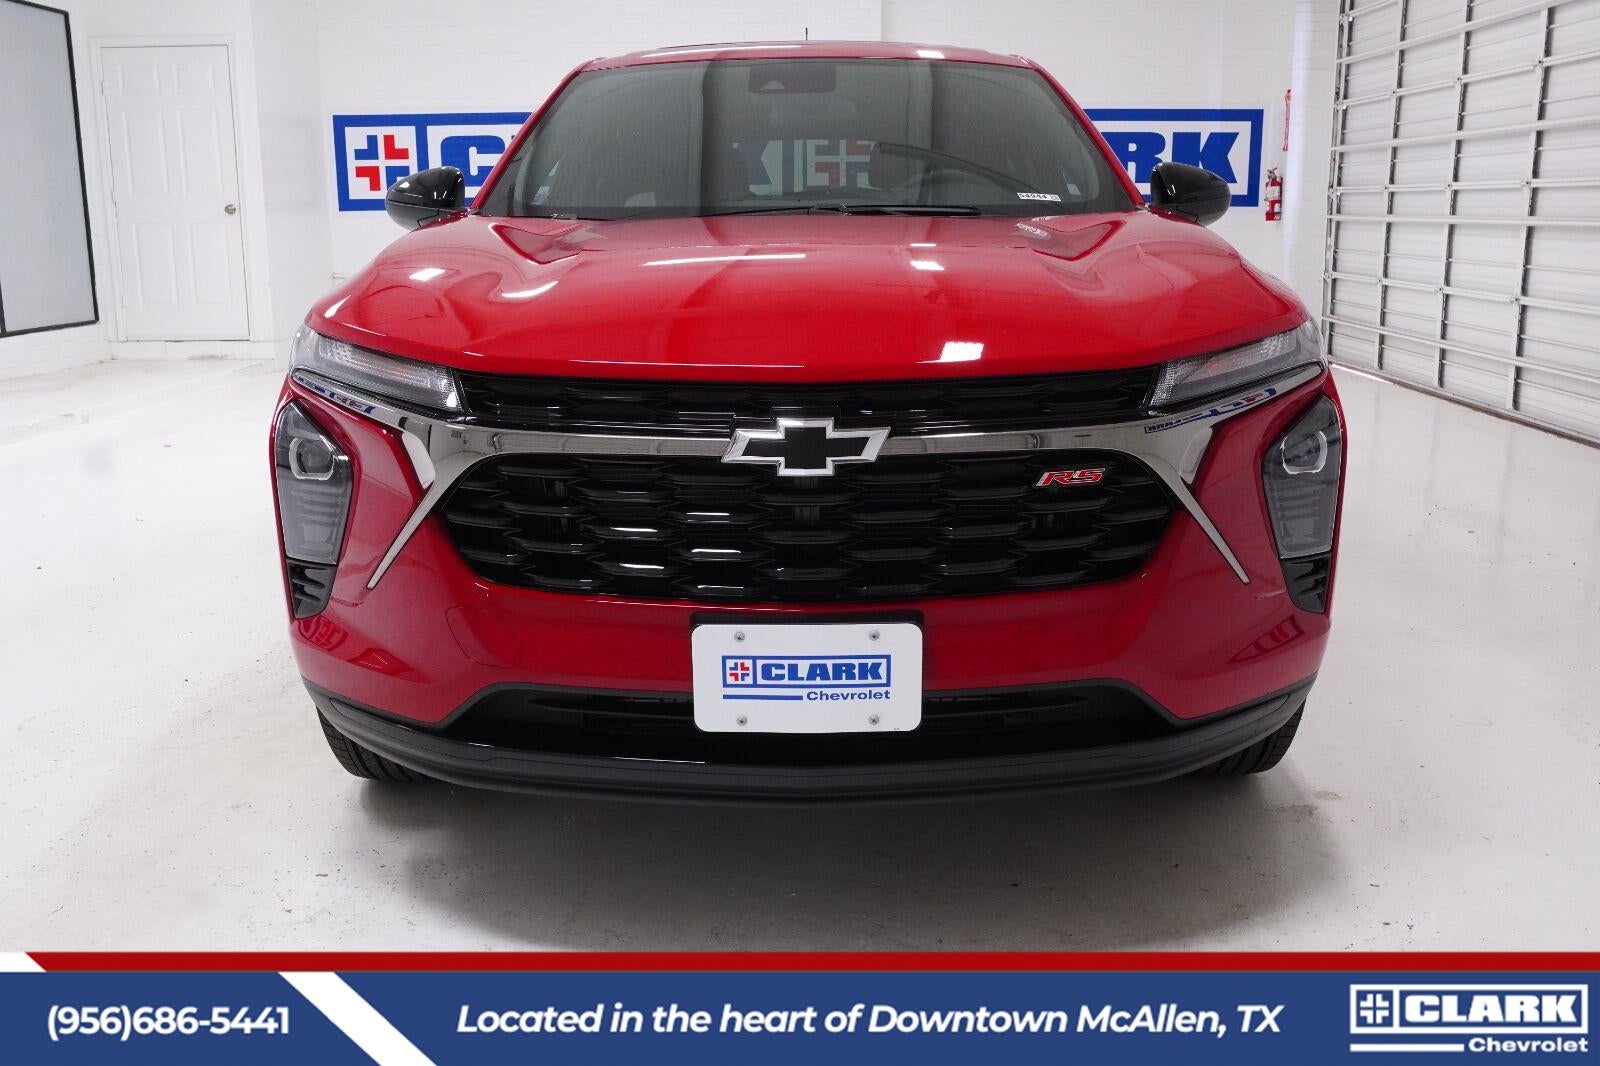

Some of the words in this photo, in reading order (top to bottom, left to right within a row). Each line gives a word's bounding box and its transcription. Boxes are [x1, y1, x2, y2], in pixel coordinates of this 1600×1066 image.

[1036, 468, 1105, 486] RS
[760, 662, 883, 681] CLARK
[806, 690, 891, 701] Chevrolet
